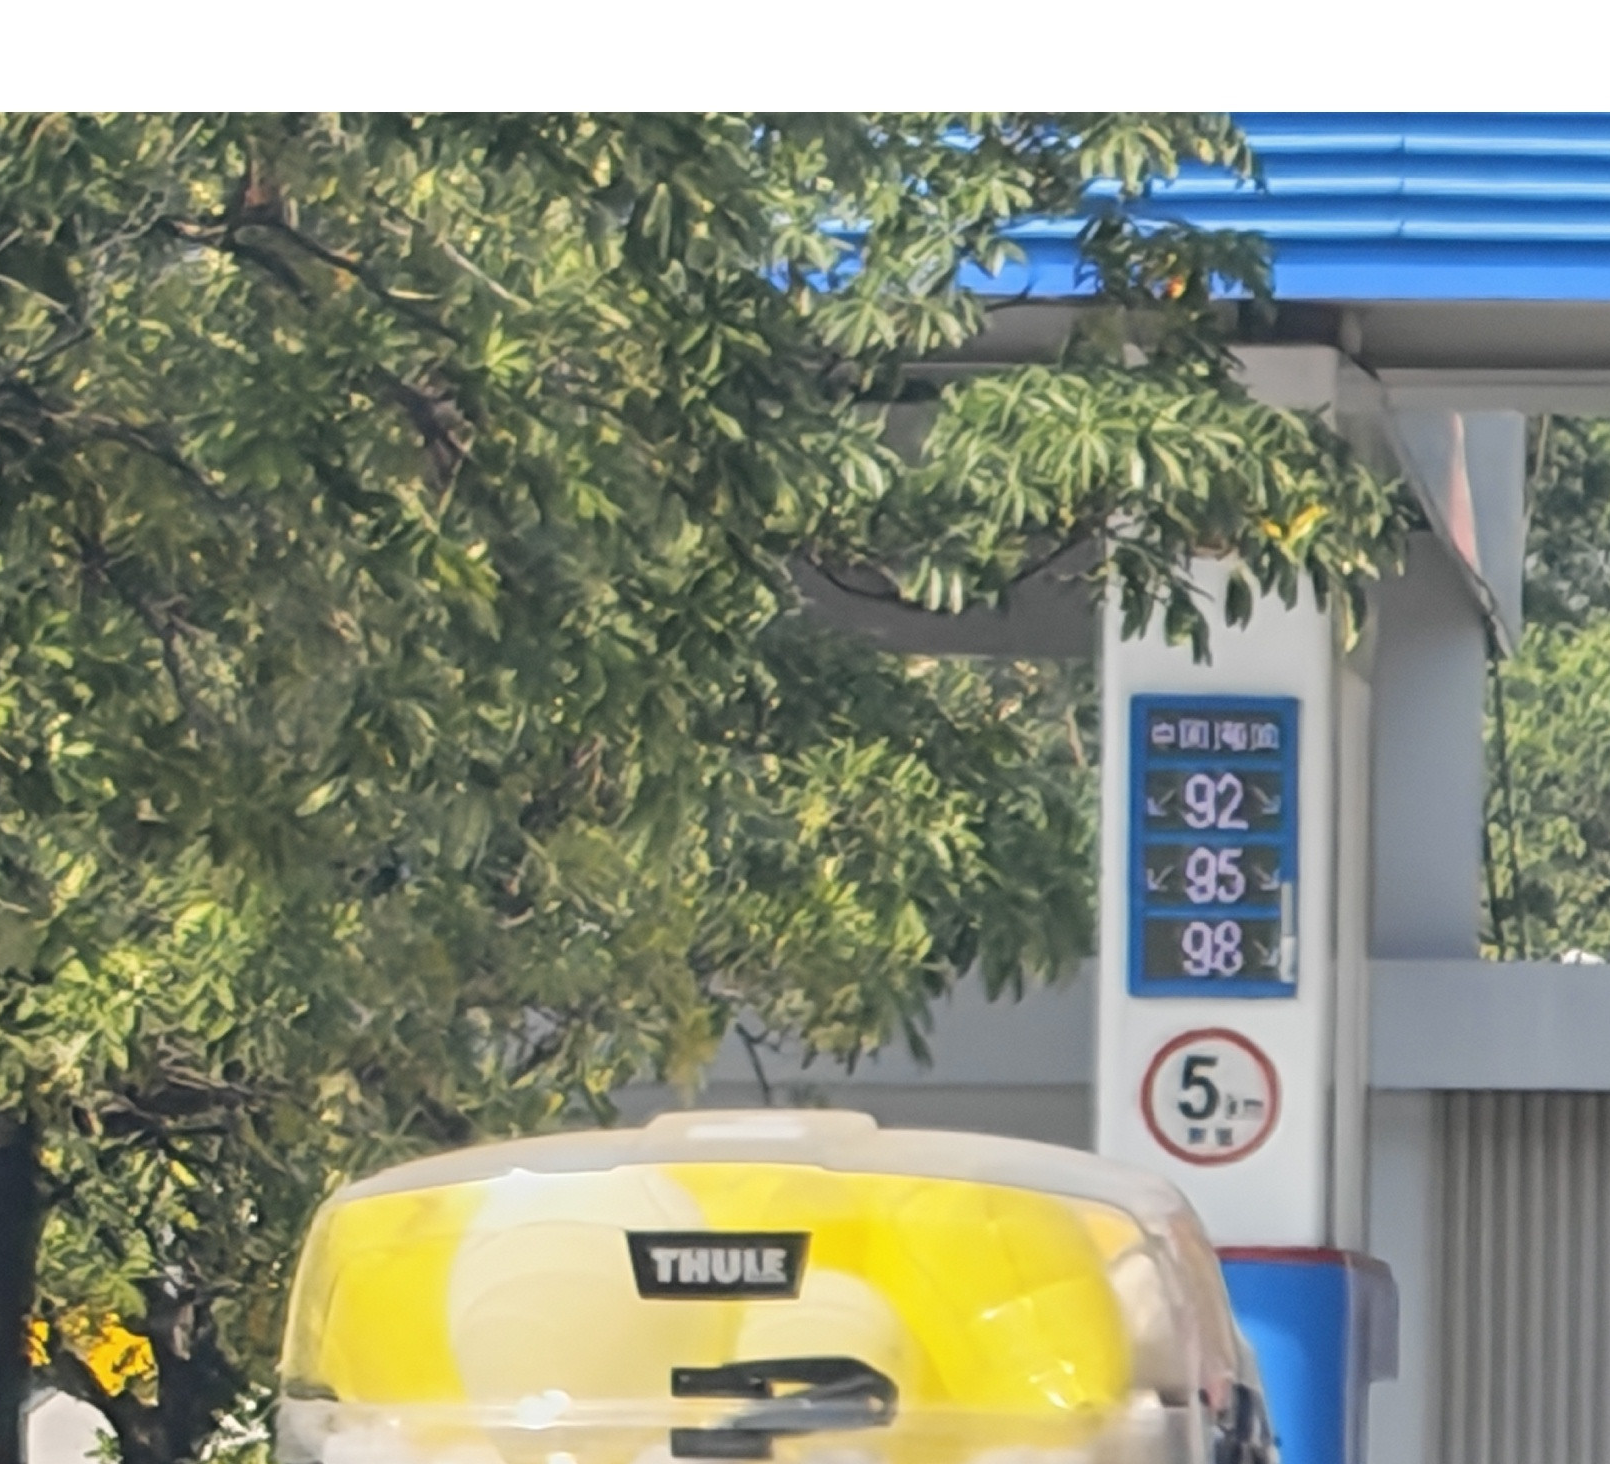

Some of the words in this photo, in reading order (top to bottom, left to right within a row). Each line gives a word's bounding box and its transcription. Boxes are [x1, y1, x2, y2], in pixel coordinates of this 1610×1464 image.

[1182, 772, 1249, 830] 92
[1186, 846, 1247, 904] 95
[1182, 919, 1244, 977] 98
[1177, 1053, 1221, 1120] 5
[649, 1246, 789, 1284] THULE
